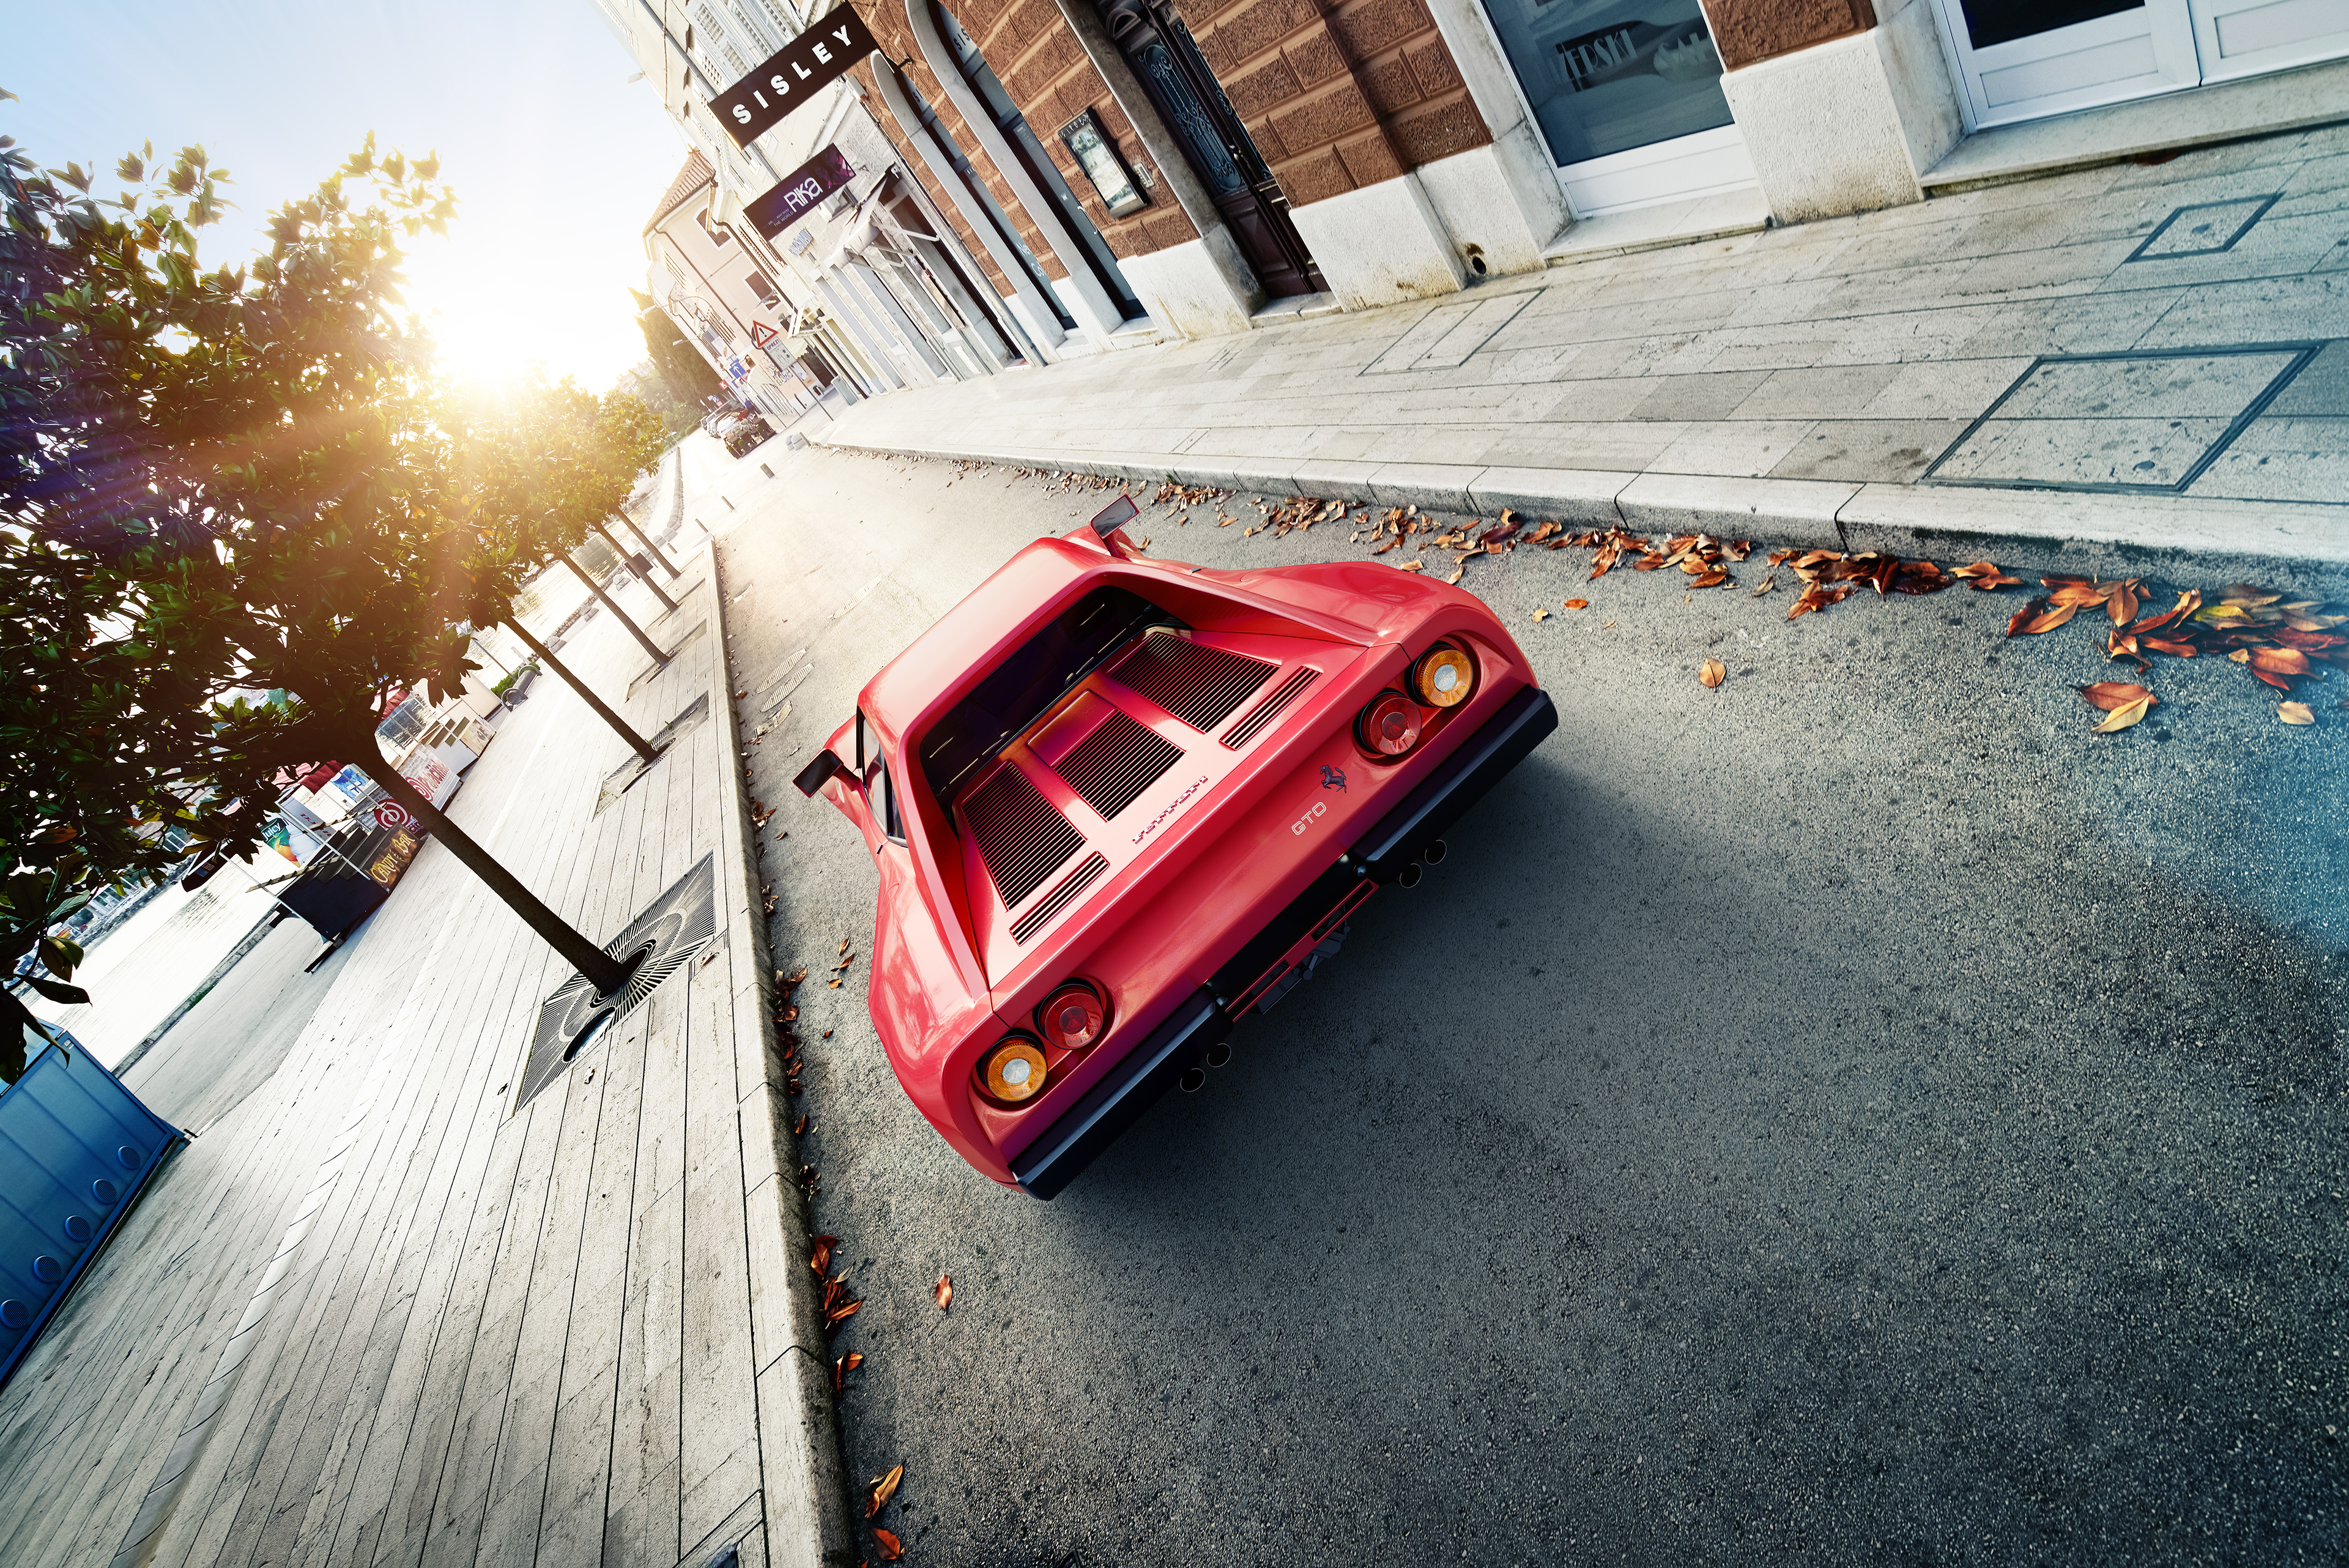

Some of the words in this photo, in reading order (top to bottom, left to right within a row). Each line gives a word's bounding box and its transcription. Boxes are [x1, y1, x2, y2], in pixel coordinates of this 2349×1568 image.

[732, 24, 852, 124] SISLEY
[261, 821, 282, 841] Juicy
[1131, 775, 1209, 845] Ferrari
[1290, 801, 1327, 835] GTO
